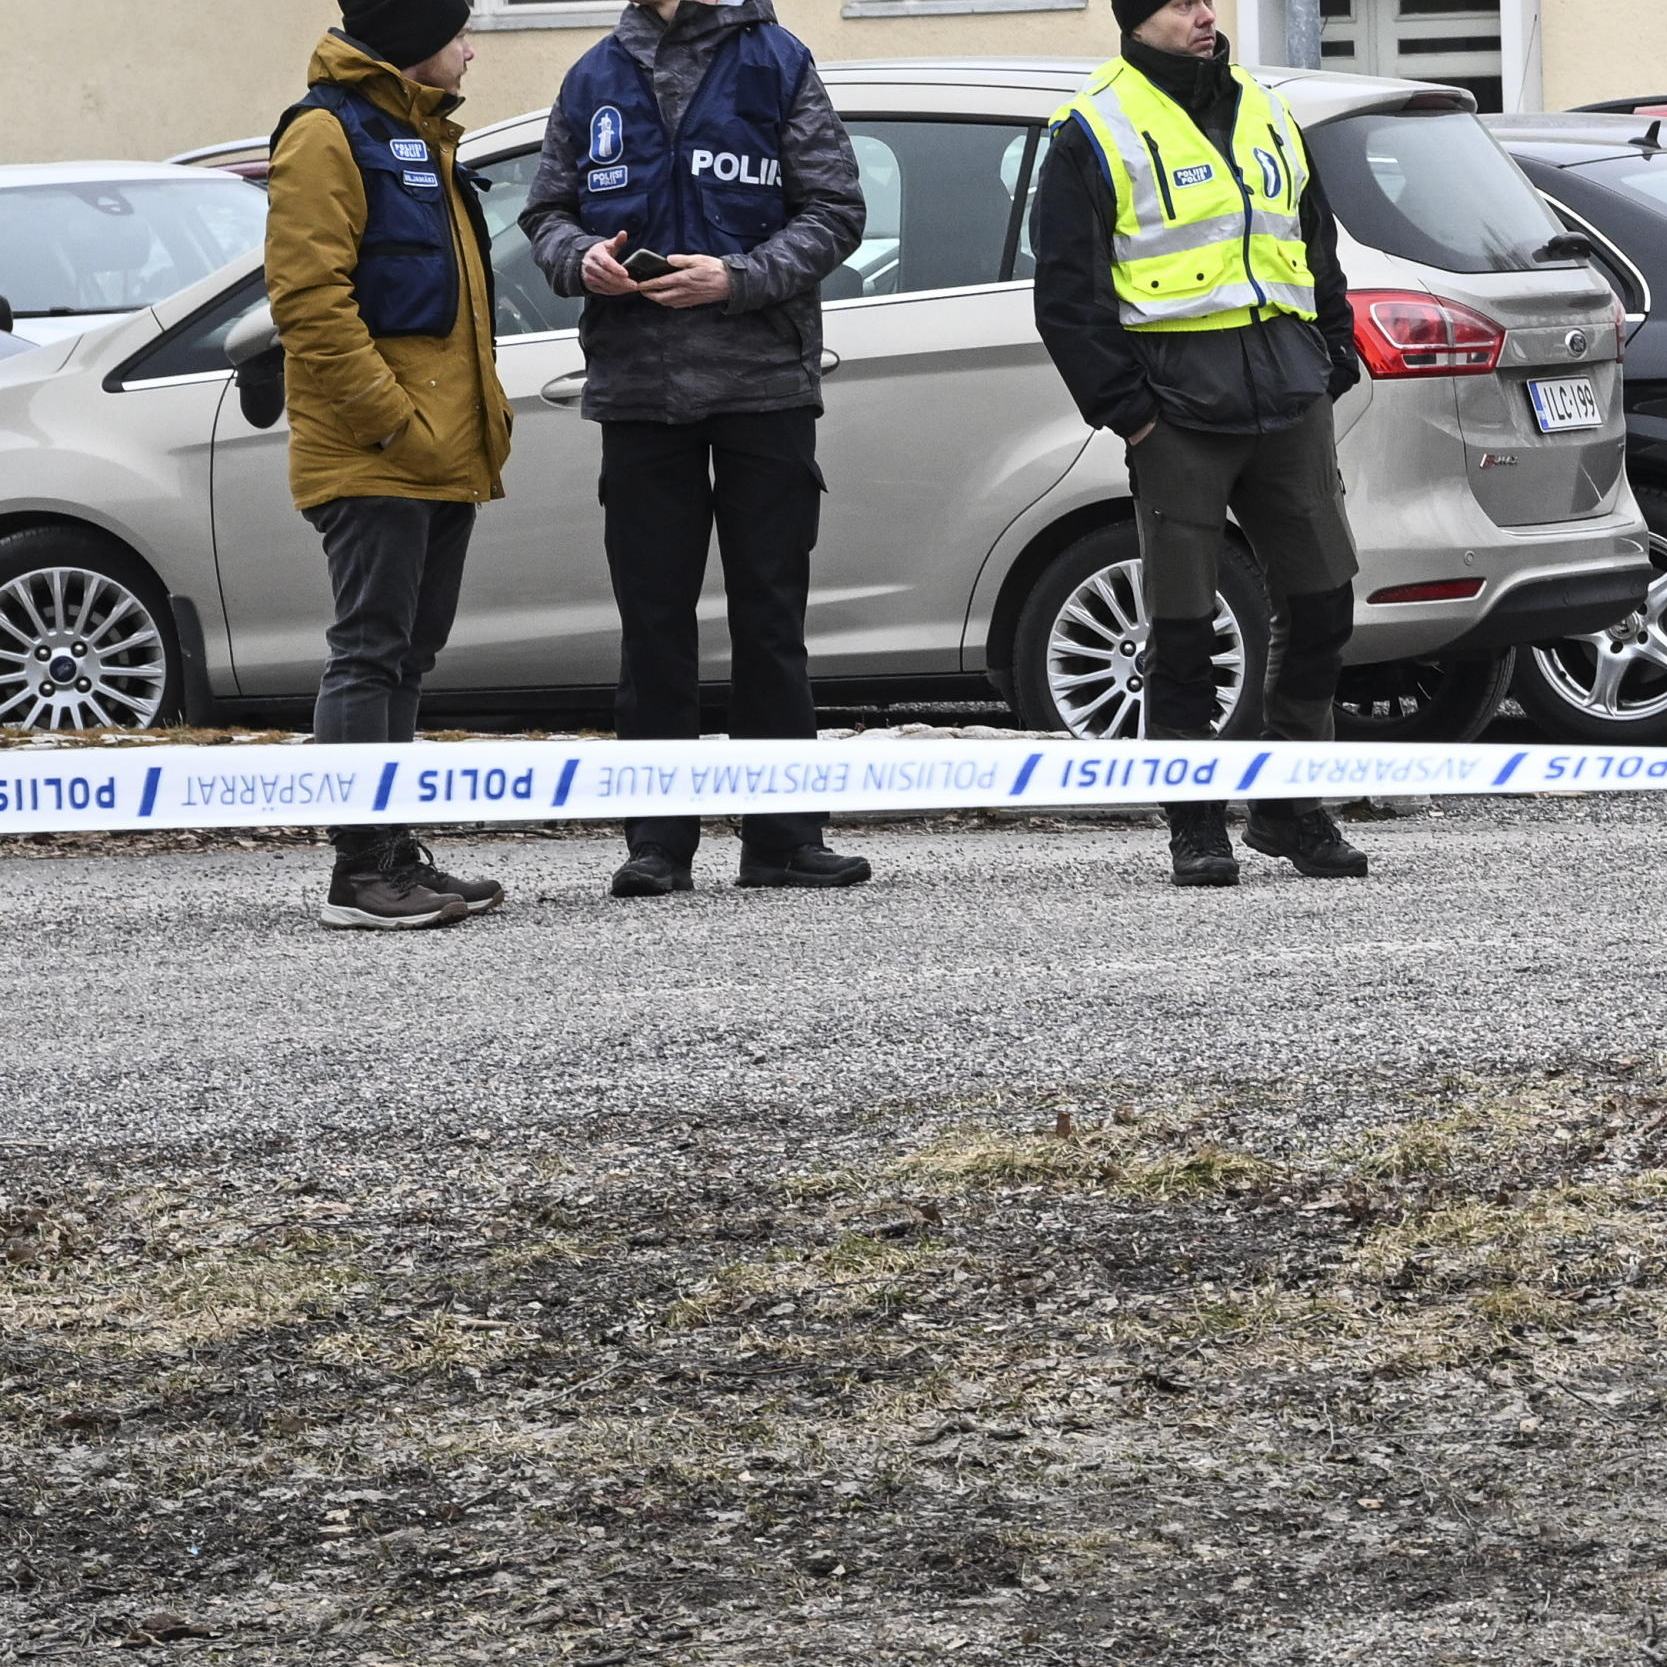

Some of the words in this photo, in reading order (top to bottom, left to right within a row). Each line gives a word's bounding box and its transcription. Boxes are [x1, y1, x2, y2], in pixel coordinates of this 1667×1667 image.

[592, 170, 623, 182] POLIISI
[1543, 384, 1596, 421] ILC-199
[416, 766, 534, 802] POLIS
[598, 765, 680, 797] ALUE
[690, 762, 850, 801] ERISTÄMÄ
[862, 760, 999, 792] POLIISIN
[1060, 757, 1219, 788] POLIISI
[181, 772, 358, 812] AVSPÄRRAT
